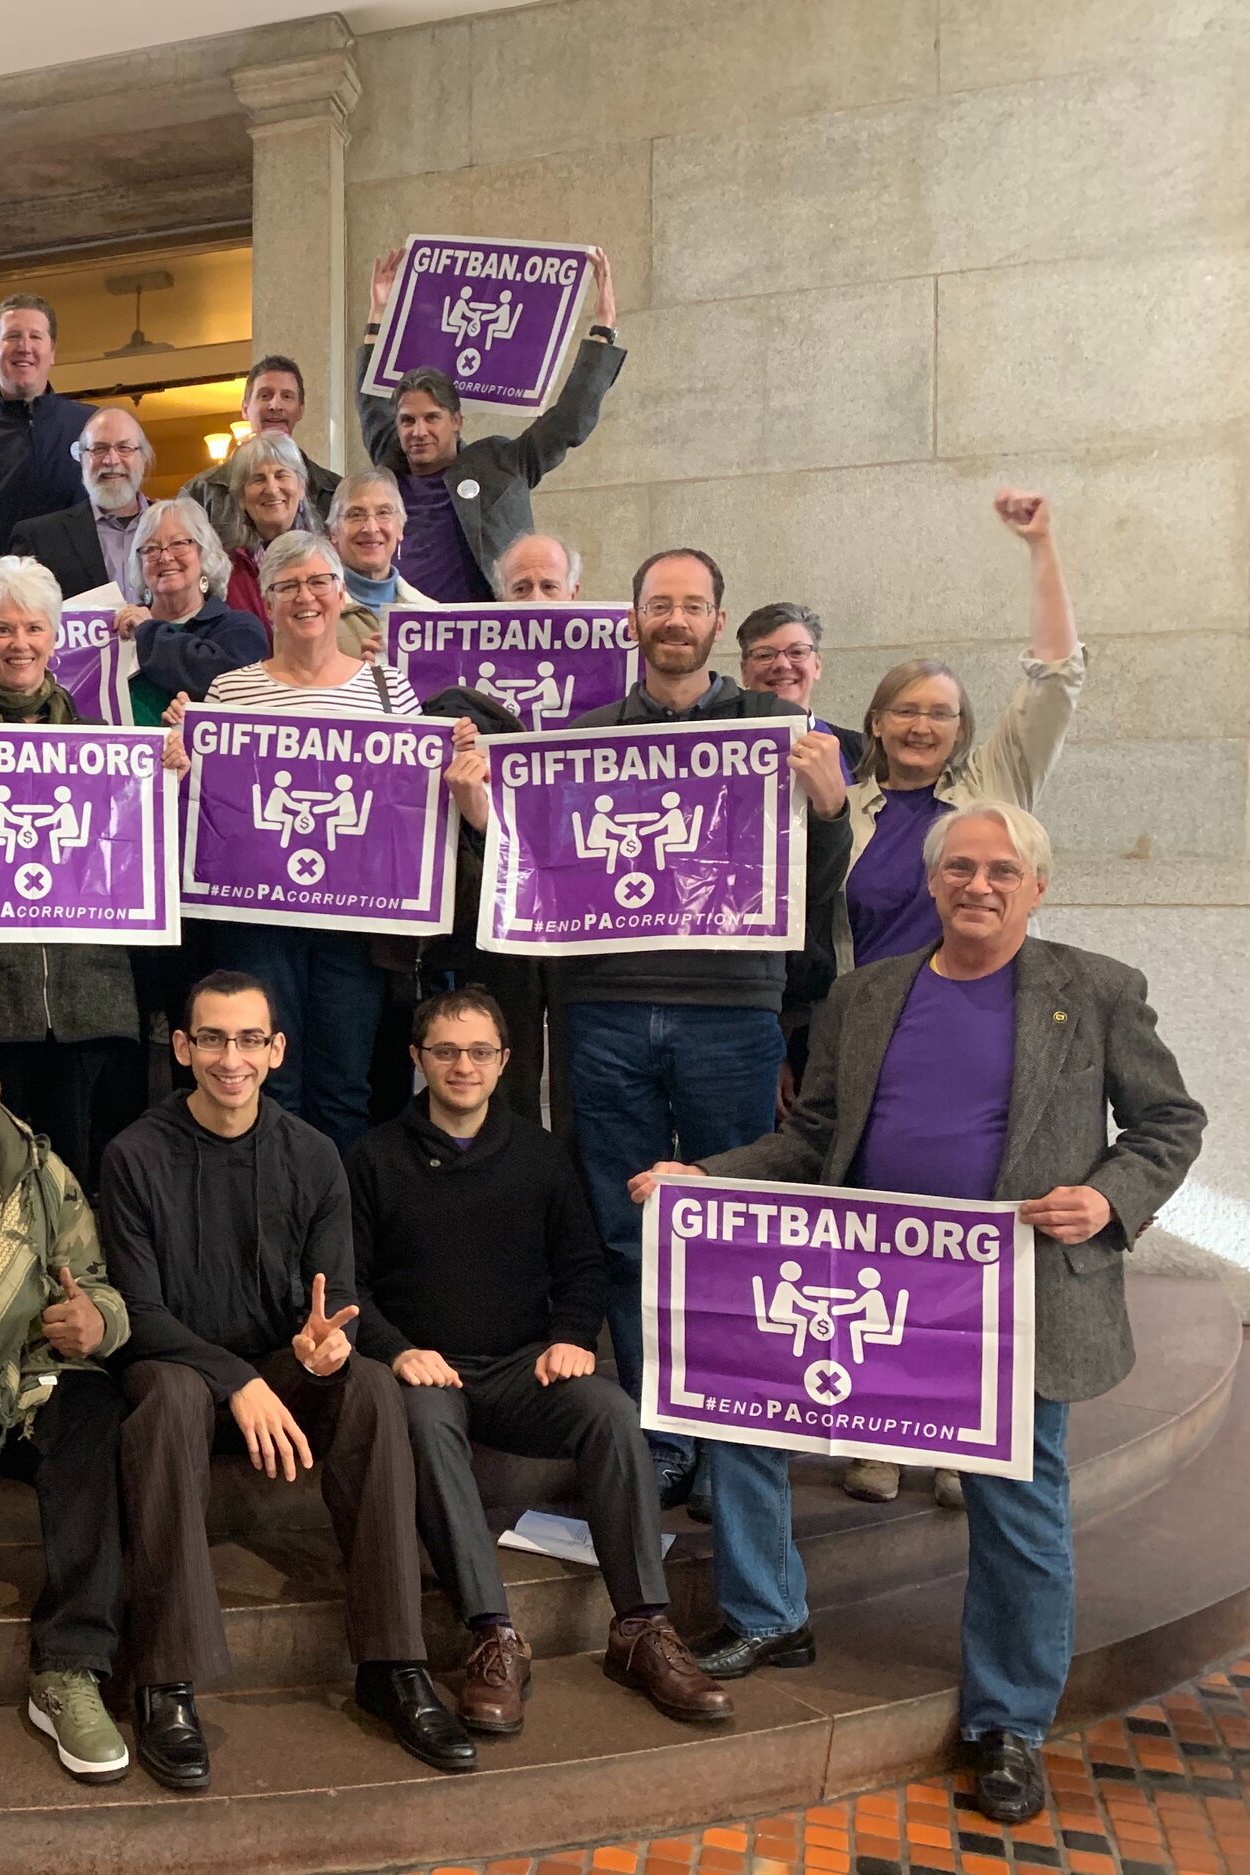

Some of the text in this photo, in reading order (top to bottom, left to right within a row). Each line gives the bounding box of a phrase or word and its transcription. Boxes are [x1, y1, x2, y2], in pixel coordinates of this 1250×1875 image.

[414, 247, 578, 285] GIFTBAN.ORG
[453, 380, 526, 398] CORRUPTION
[192, 721, 443, 769] GIFTBAN.ORG
[501, 739, 778, 787] GIFTBAN.ORG
[210, 883, 400, 909] #ENDPACORRUPTION
[533, 911, 741, 934] #ENDPACORRUPTION
[672, 1198, 1000, 1264] GIFTBAN.ORG
[706, 1396, 956, 1441] #ENDPACORRUPTION
